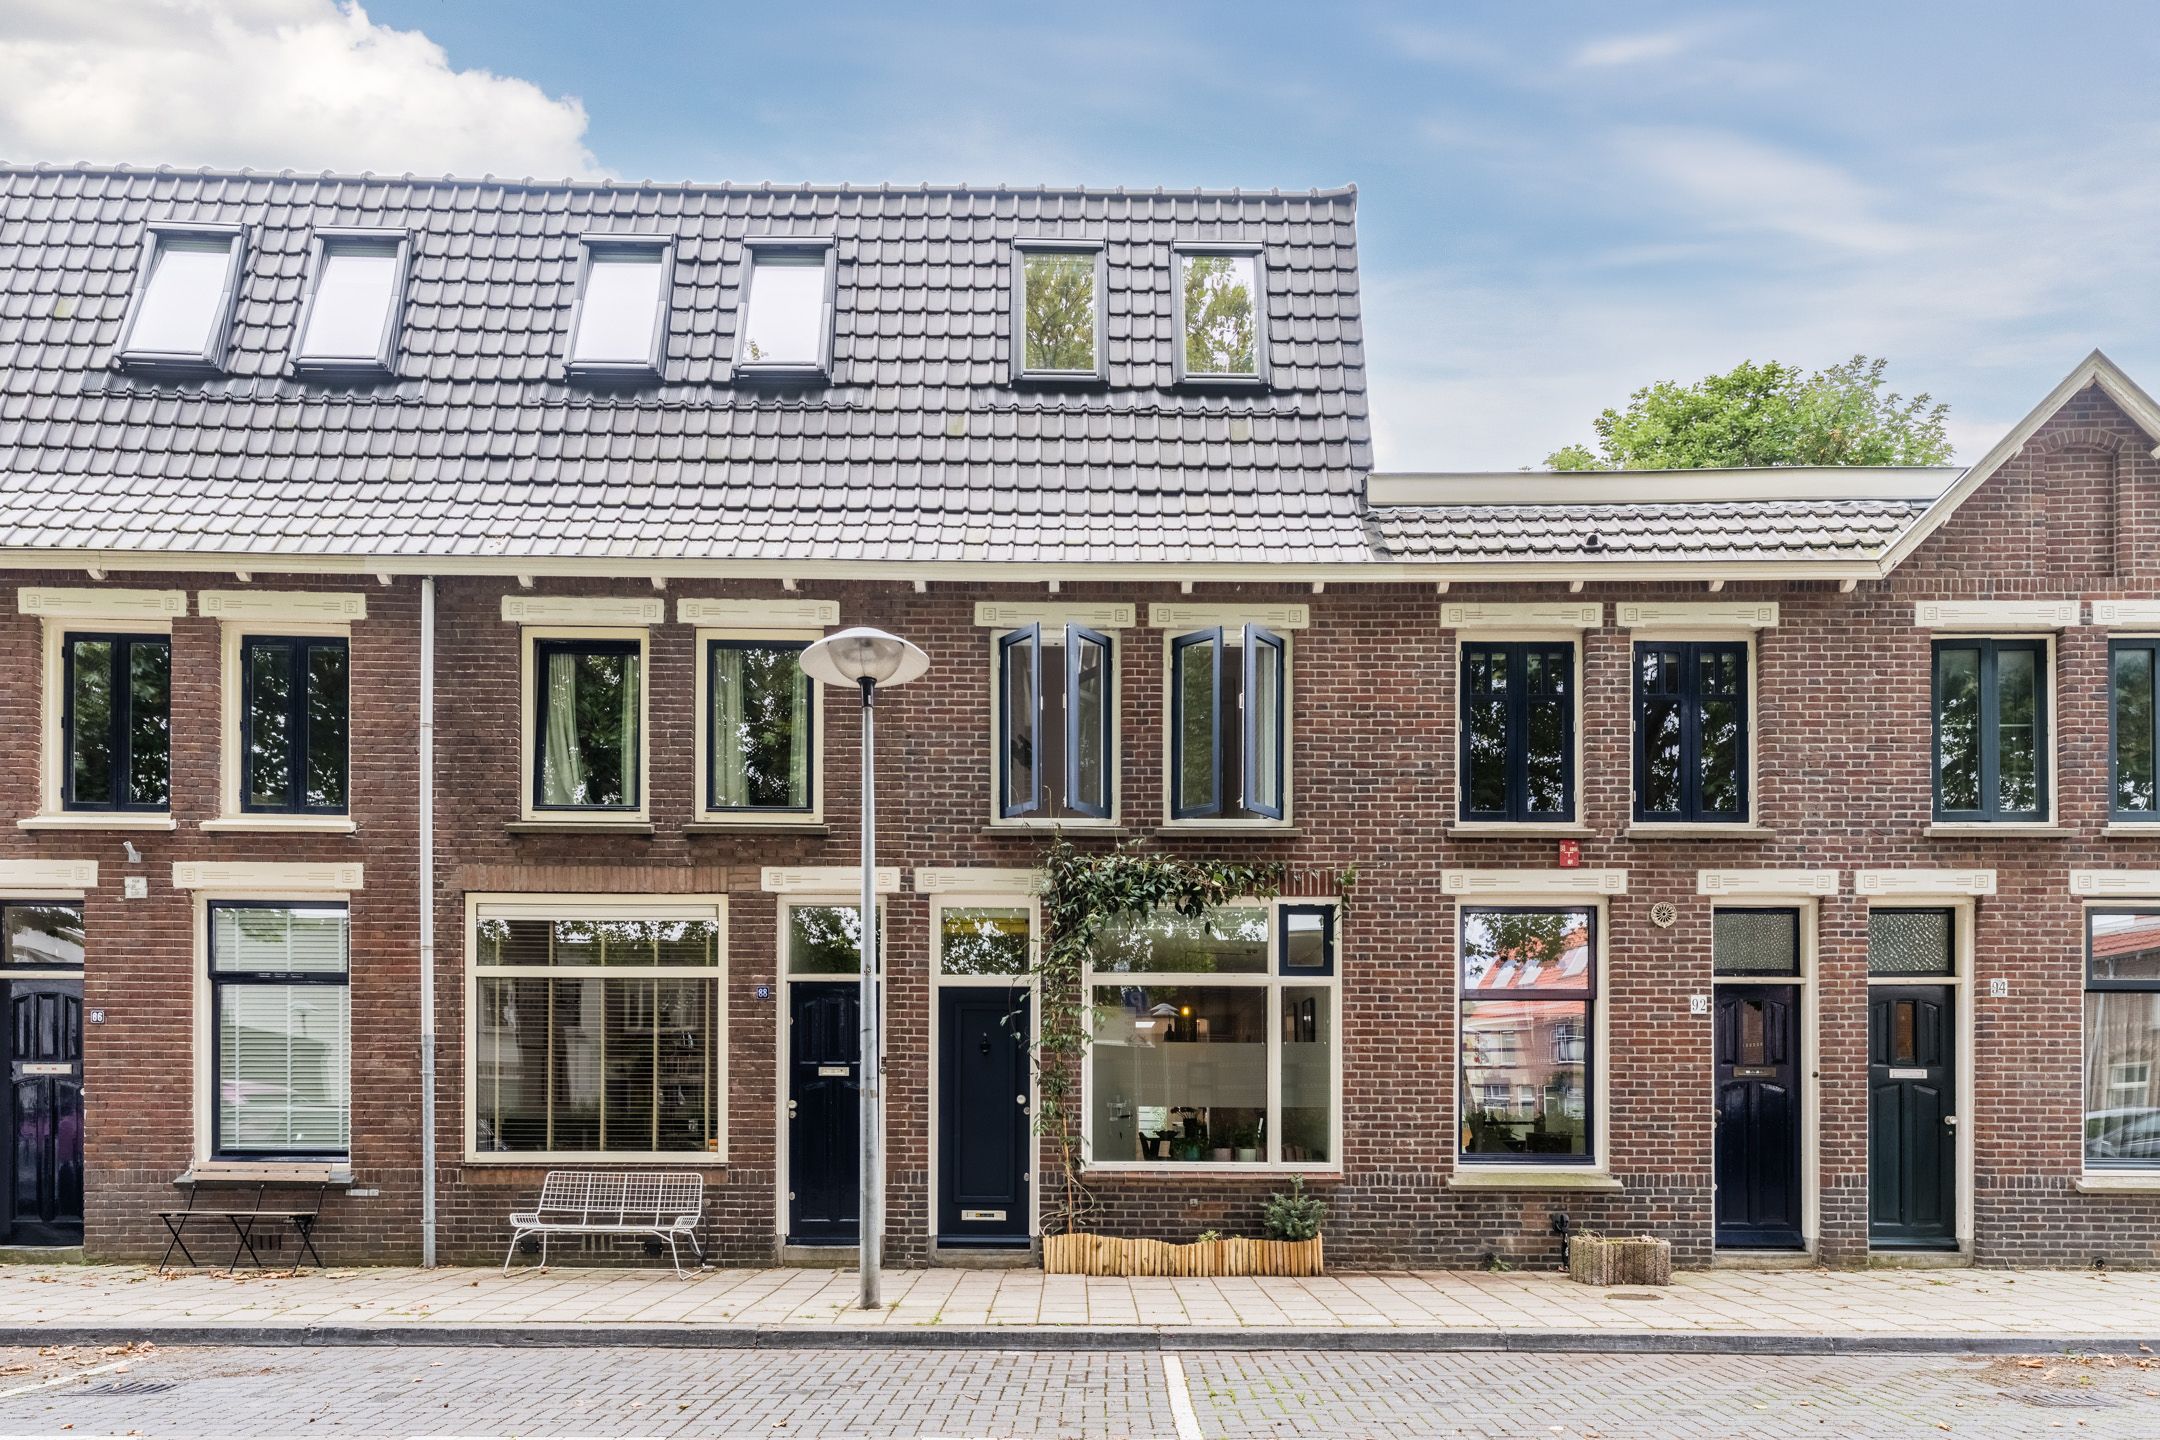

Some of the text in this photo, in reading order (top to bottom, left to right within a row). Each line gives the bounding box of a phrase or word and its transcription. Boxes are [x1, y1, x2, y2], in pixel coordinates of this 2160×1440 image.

[758, 988, 768, 998] 88
[1992, 981, 2005, 994] 94
[1692, 998, 1706, 1010] 92
[92, 1012, 103, 1022] 86
